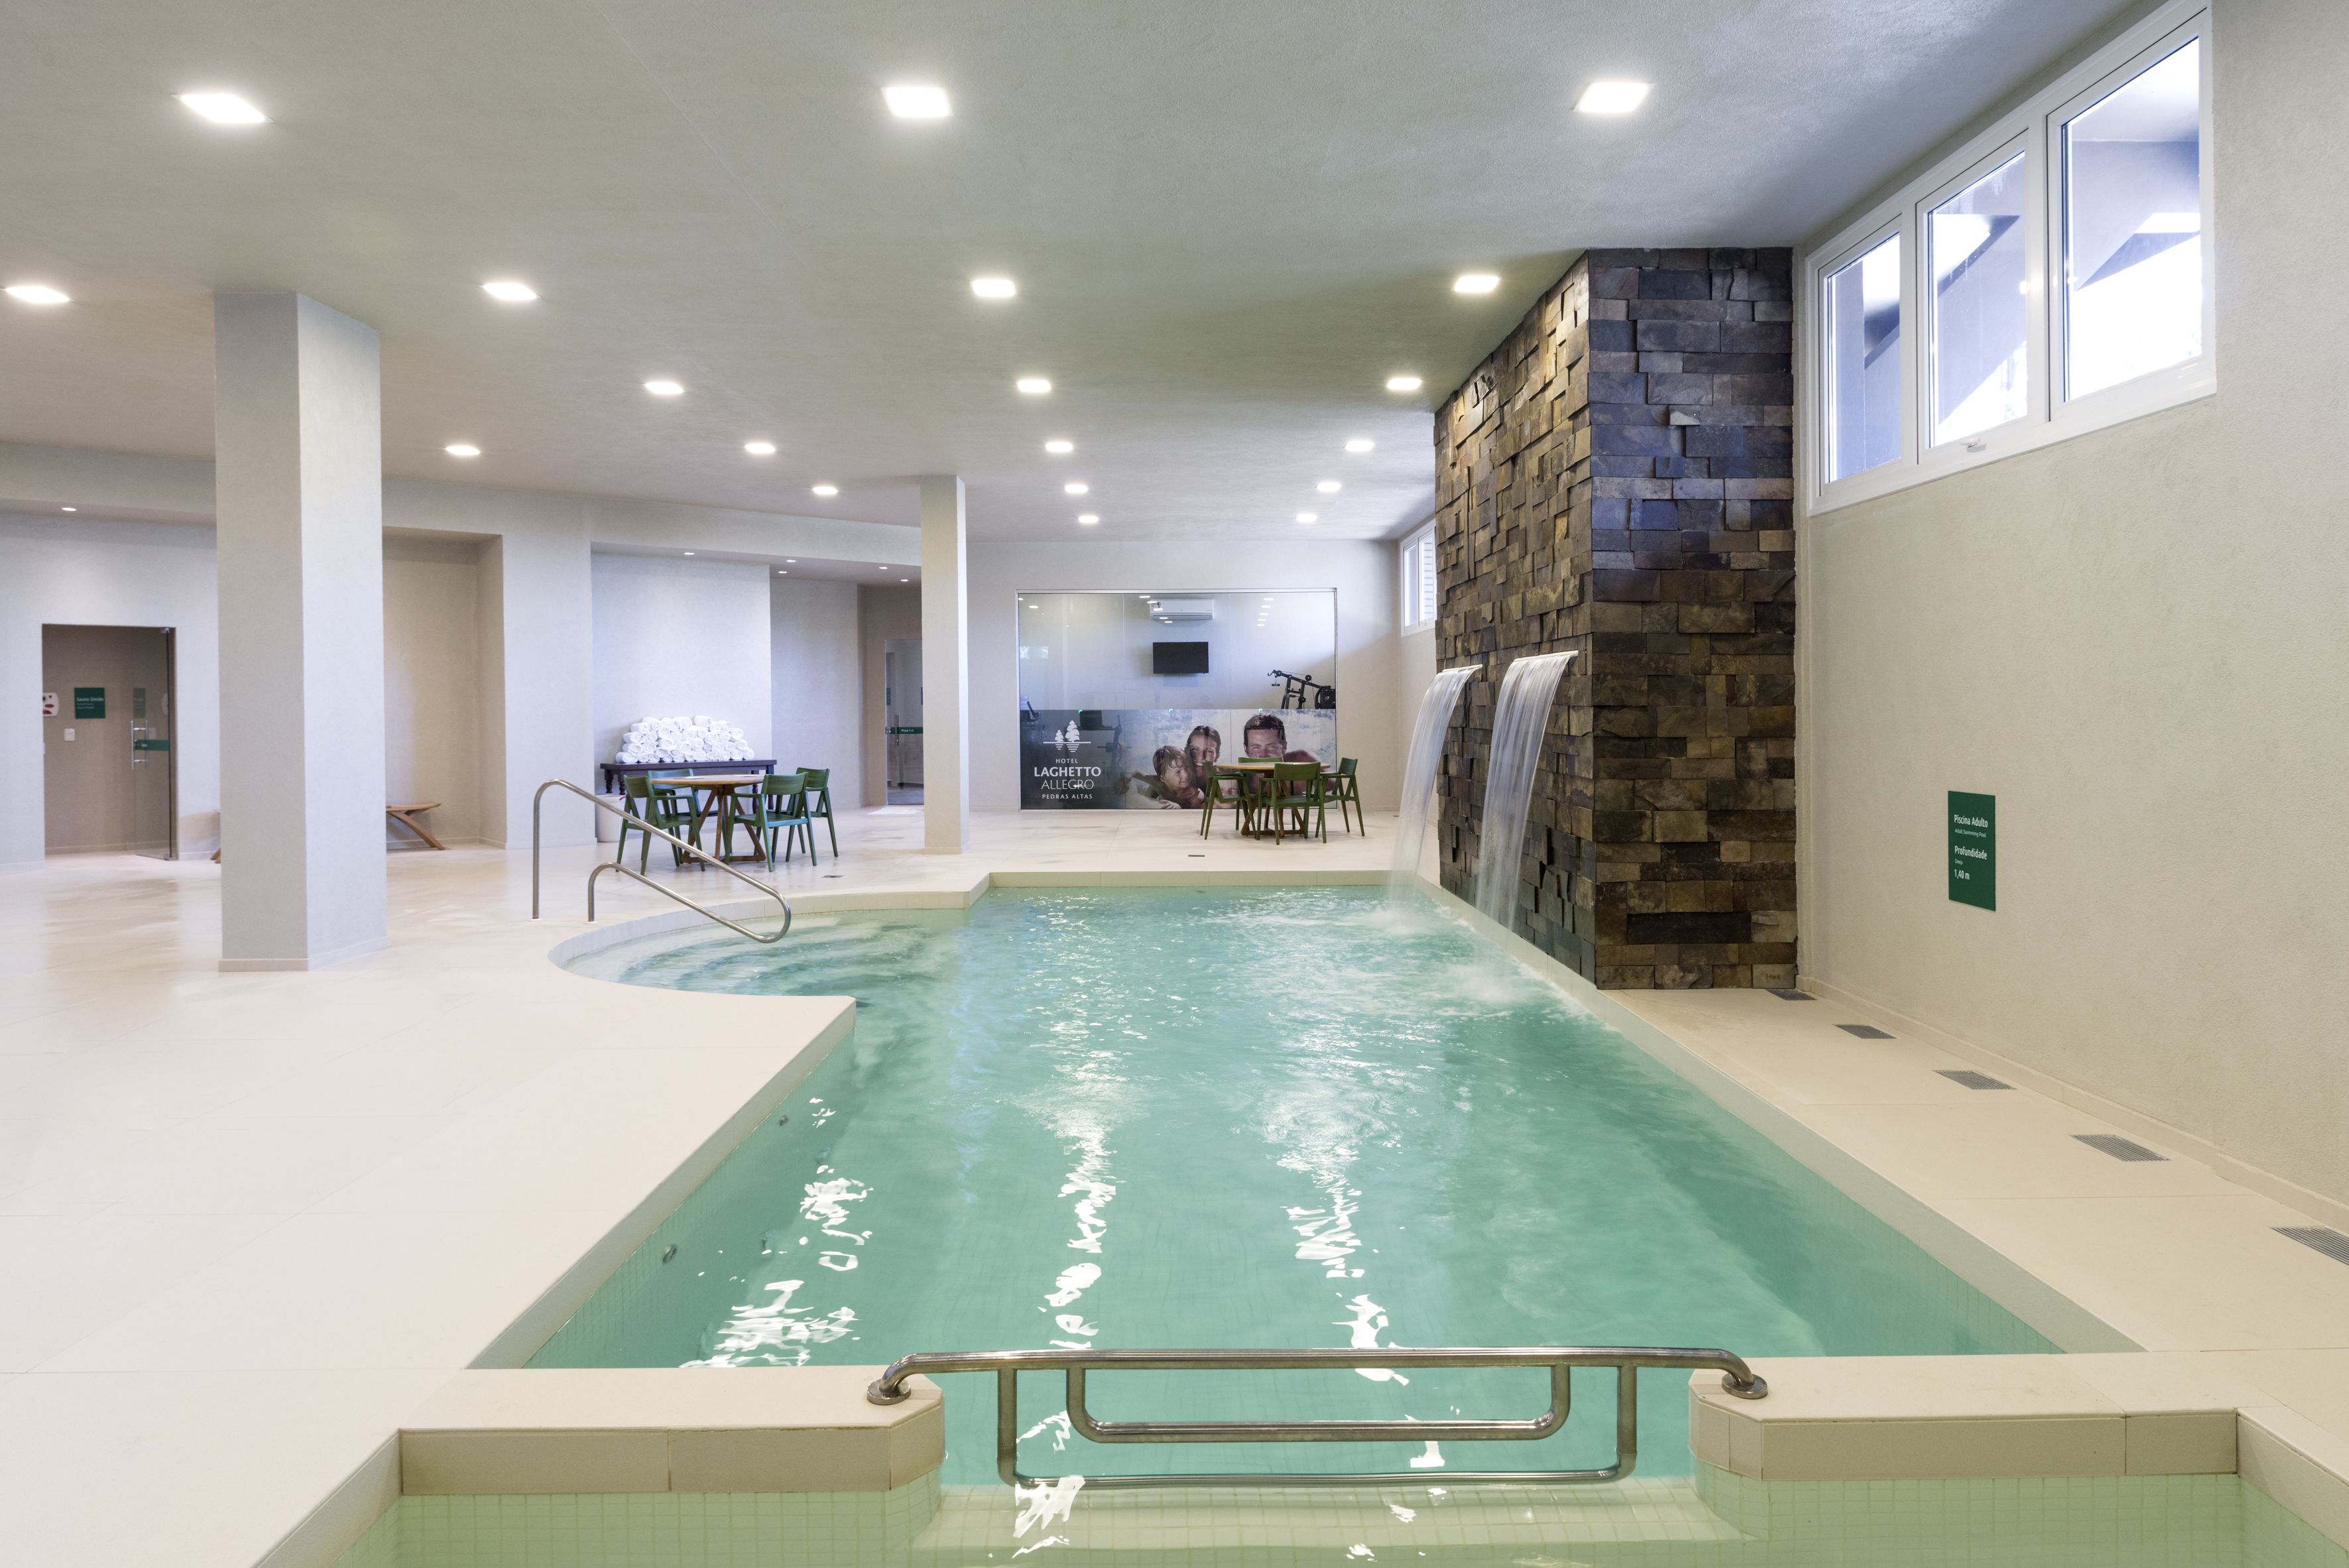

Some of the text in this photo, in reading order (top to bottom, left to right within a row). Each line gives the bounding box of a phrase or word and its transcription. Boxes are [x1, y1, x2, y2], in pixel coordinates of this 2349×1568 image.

[1034, 766, 1101, 776] LAGHETTO
[1041, 779, 1094, 790] ALLEGRO
[1954, 814, 1988, 827] Piscina Adulto
[1955, 845, 1987, 859] Profundidade
[1954, 869, 1964, 879] 1,40
